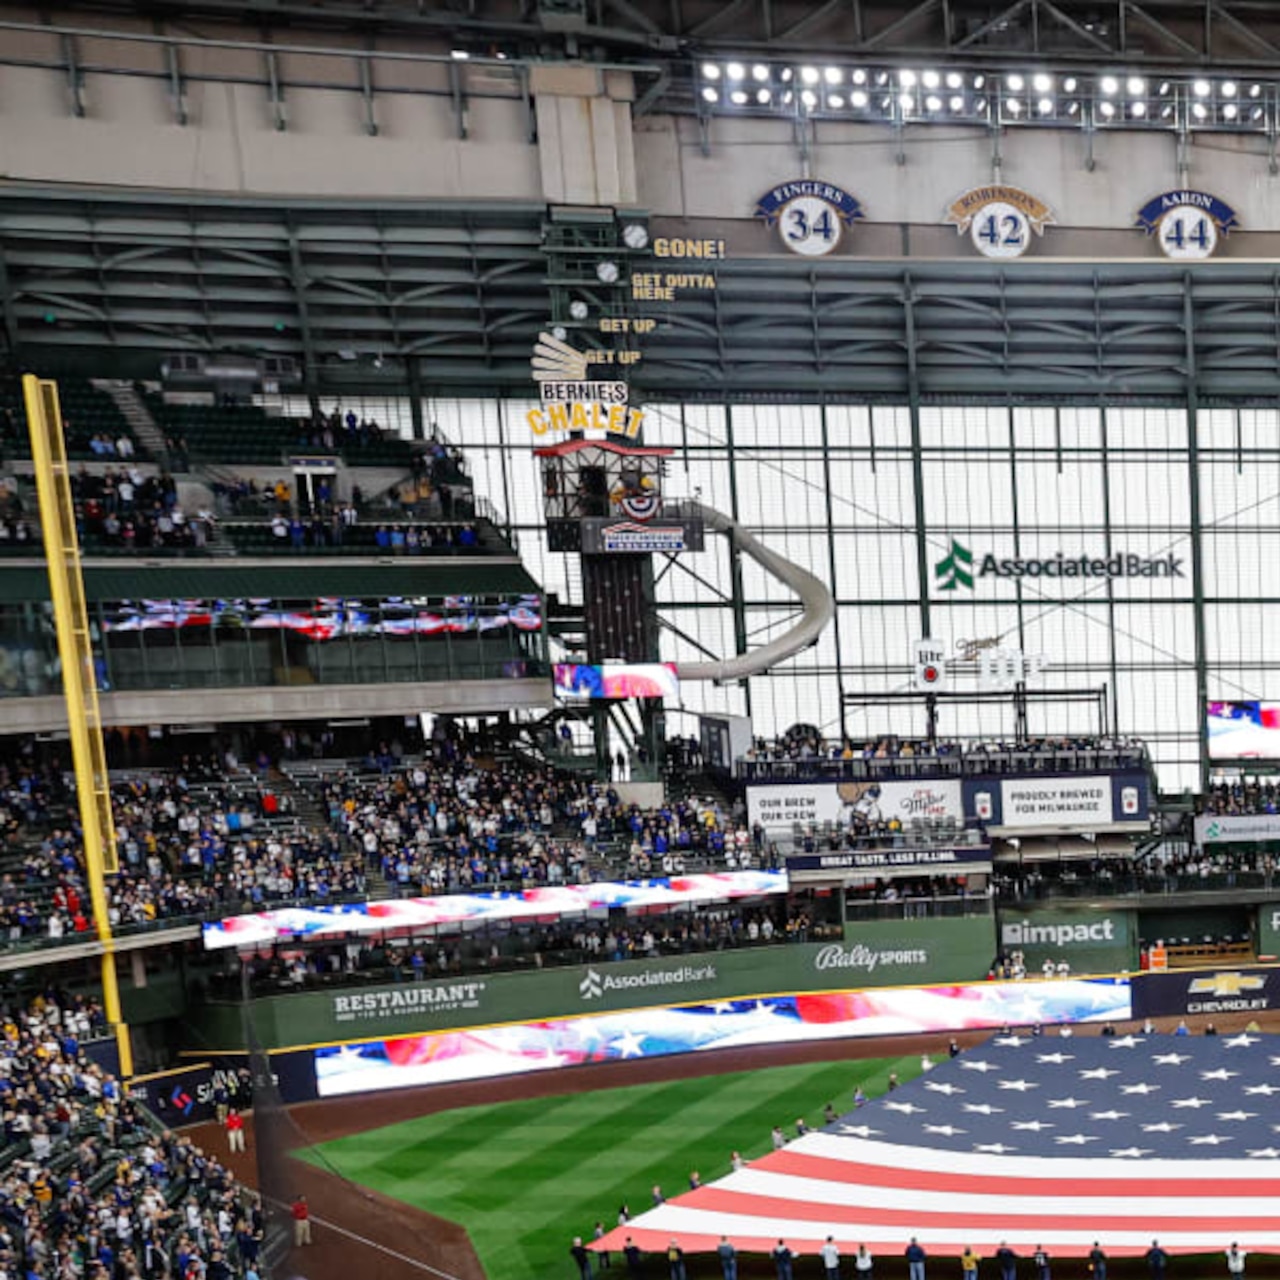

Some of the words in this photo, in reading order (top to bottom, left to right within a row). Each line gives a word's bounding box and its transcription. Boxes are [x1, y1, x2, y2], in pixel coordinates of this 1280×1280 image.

[773, 182, 843, 204] FINGERS
[1161, 191, 1213, 208] AARON
[788, 208, 834, 243] 34
[978, 214, 1023, 245] 42
[1165, 218, 1209, 250] 44
[653, 238, 726, 260] GONE!
[631, 273, 663, 289] GET
[665, 274, 716, 290] OUTTA
[632, 286, 675, 301] HERE
[600, 318, 630, 333] GET
[633, 319, 657, 334] UP
[584, 350, 617, 365] GET
[619, 350, 642, 365] UP
[543, 383, 627, 402] BERNIE'S
[526, 403, 647, 439] CHALET
[978, 552, 1186, 578] AssociatedBank
[1021, 919, 1115, 946] impact
[815, 944, 879, 972] Bally
[879, 949, 927, 966] SPORTS
[603, 965, 717, 991] AssociatedBank
[335, 982, 479, 1013] RESTAURANT
[1187, 998, 1270, 1014] CHEVROLET
